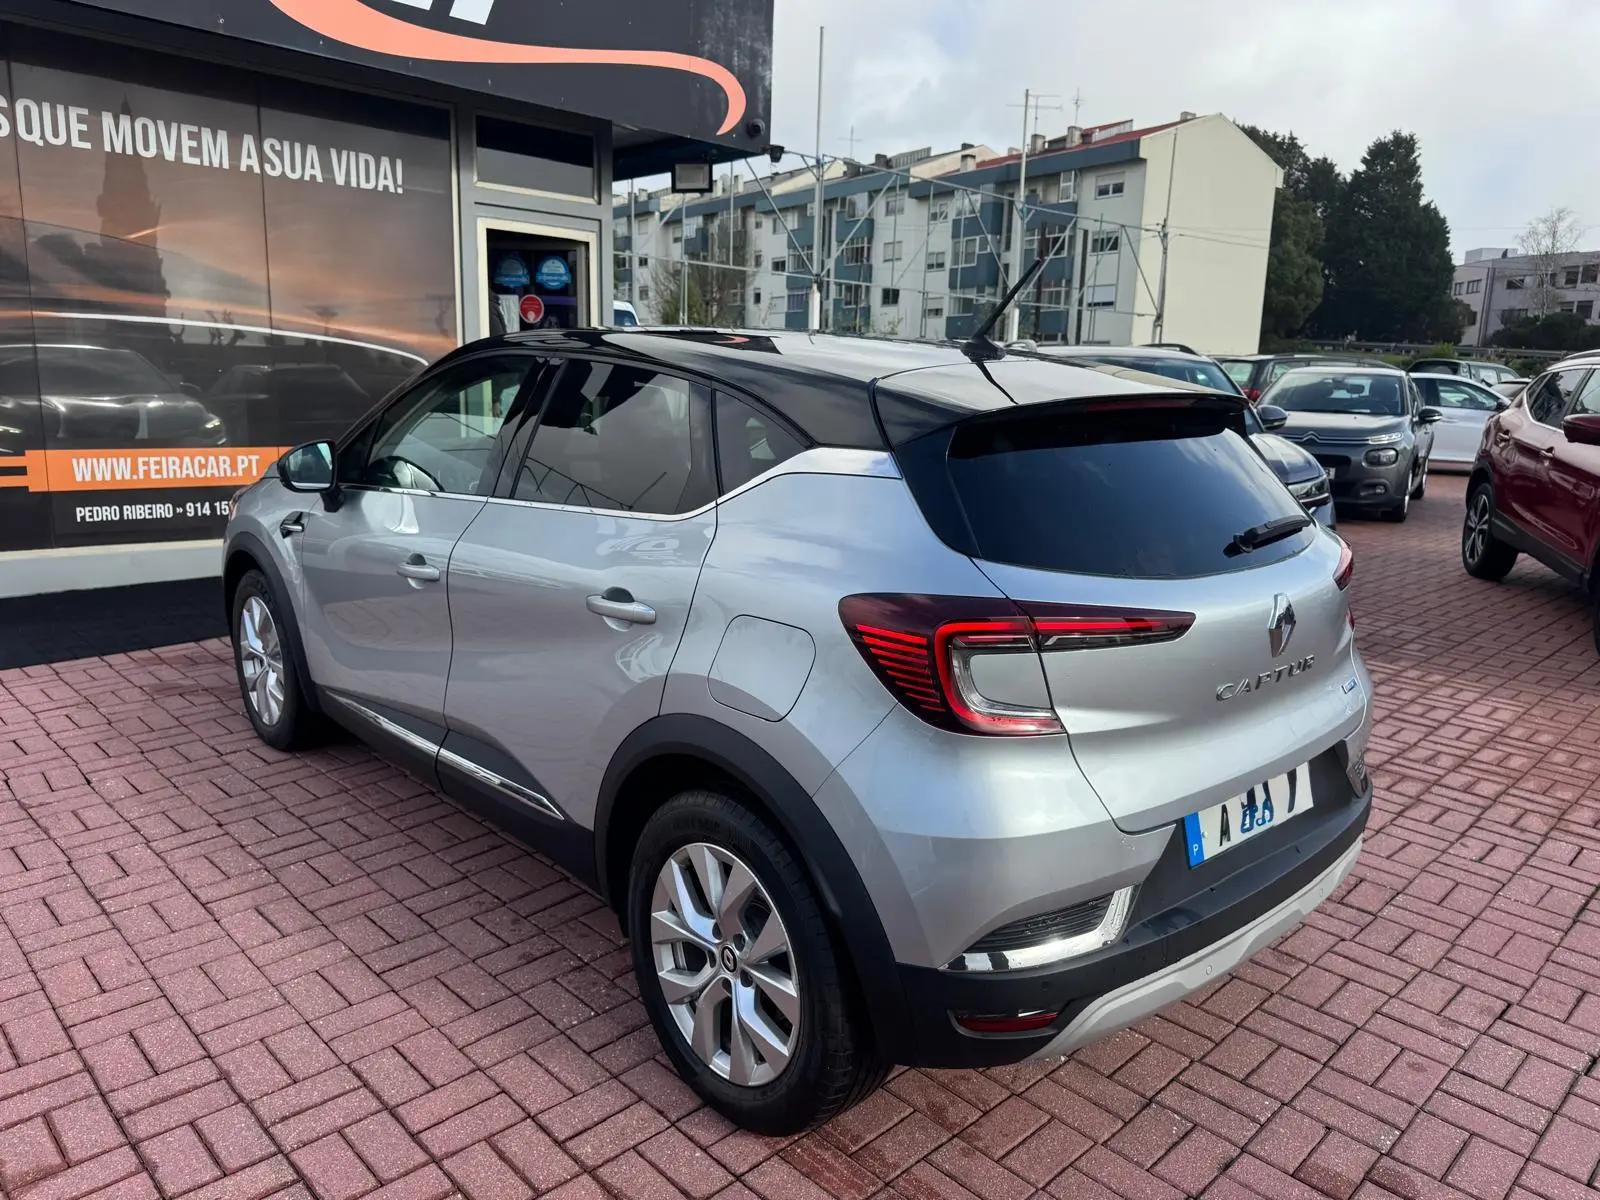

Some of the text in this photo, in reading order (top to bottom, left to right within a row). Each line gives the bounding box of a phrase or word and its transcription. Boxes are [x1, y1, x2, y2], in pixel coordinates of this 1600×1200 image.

[15, 98, 92, 149] QUE
[101, 111, 229, 170] MOVEM
[330, 148, 403, 194] VIDA!
[72, 455, 260, 482] WWW.FEIRACAR.PT
[76, 506, 120, 522] PEDRO
[123, 503, 174, 520] RIBEIRO
[186, 502, 211, 517] 914
[1216, 654, 1315, 701] CAPTUR
